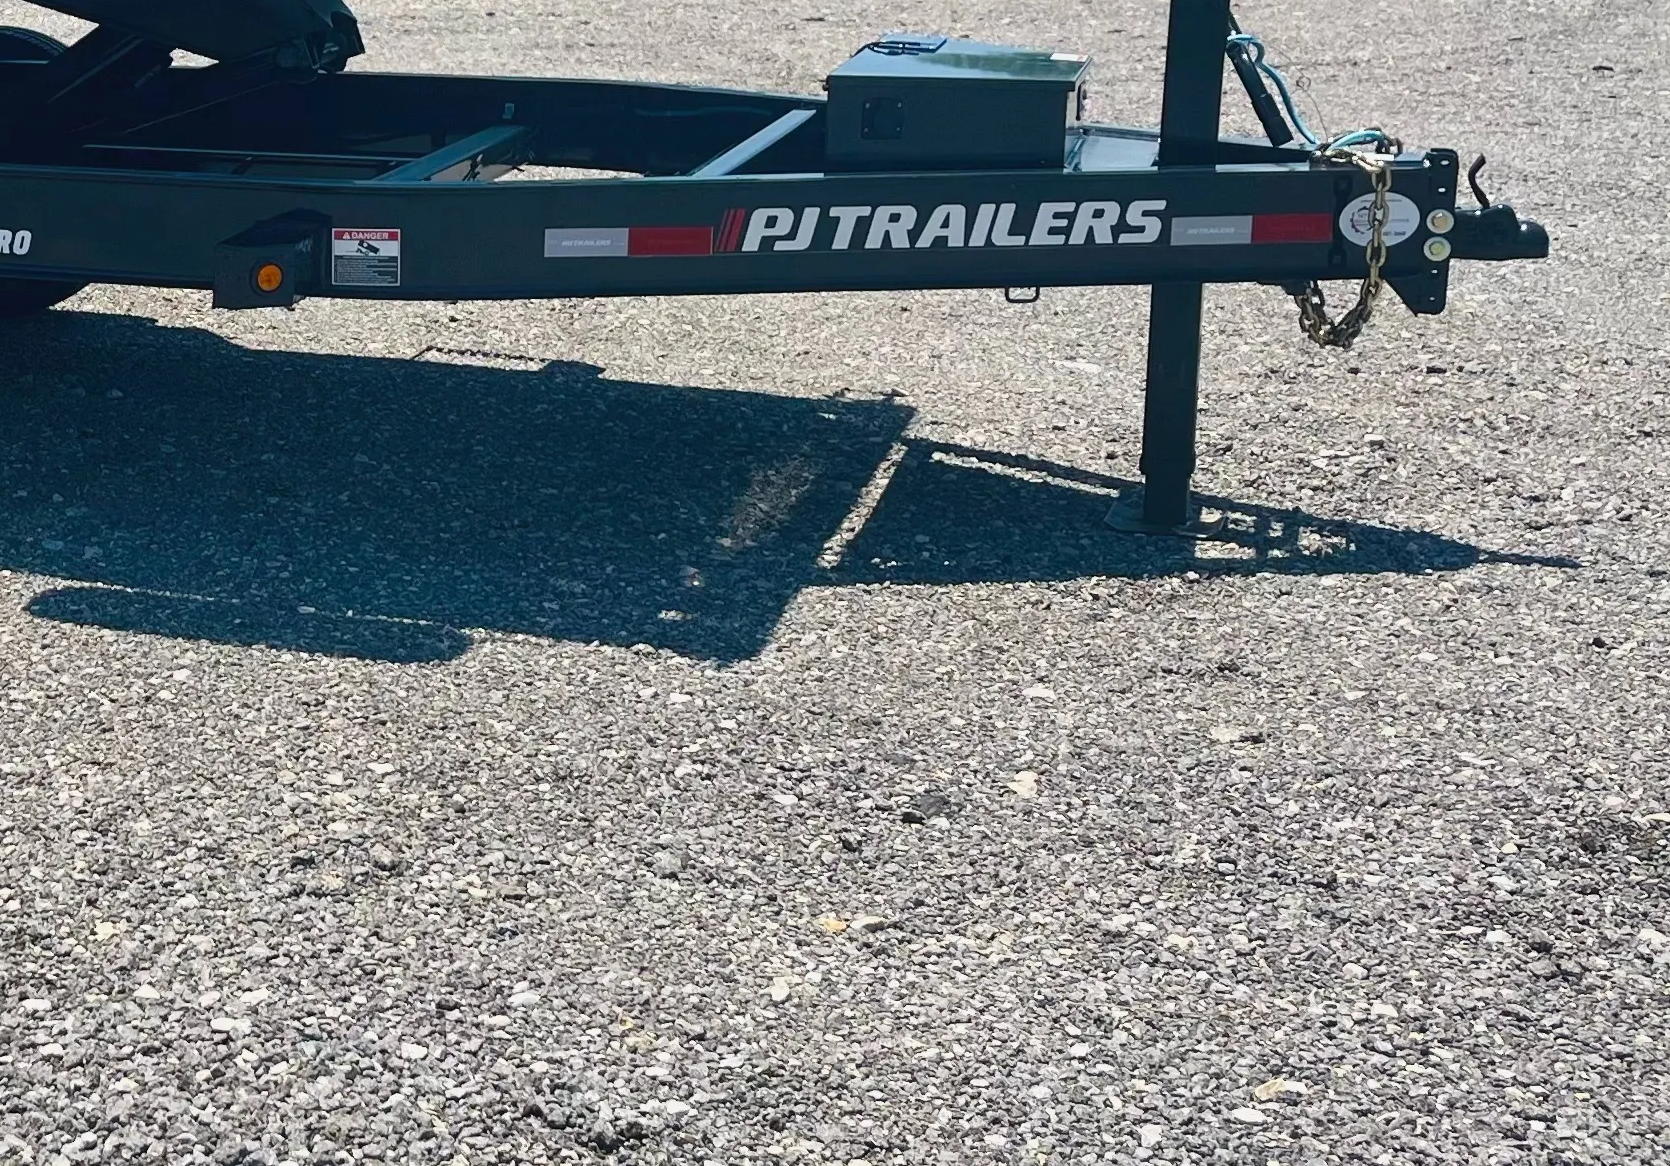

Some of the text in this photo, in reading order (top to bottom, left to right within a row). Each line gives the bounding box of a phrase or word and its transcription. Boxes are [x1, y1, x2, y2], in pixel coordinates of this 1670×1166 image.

[351, 231, 389, 240] DANGER
[741, 199, 1167, 252] PJ TRAILERS
